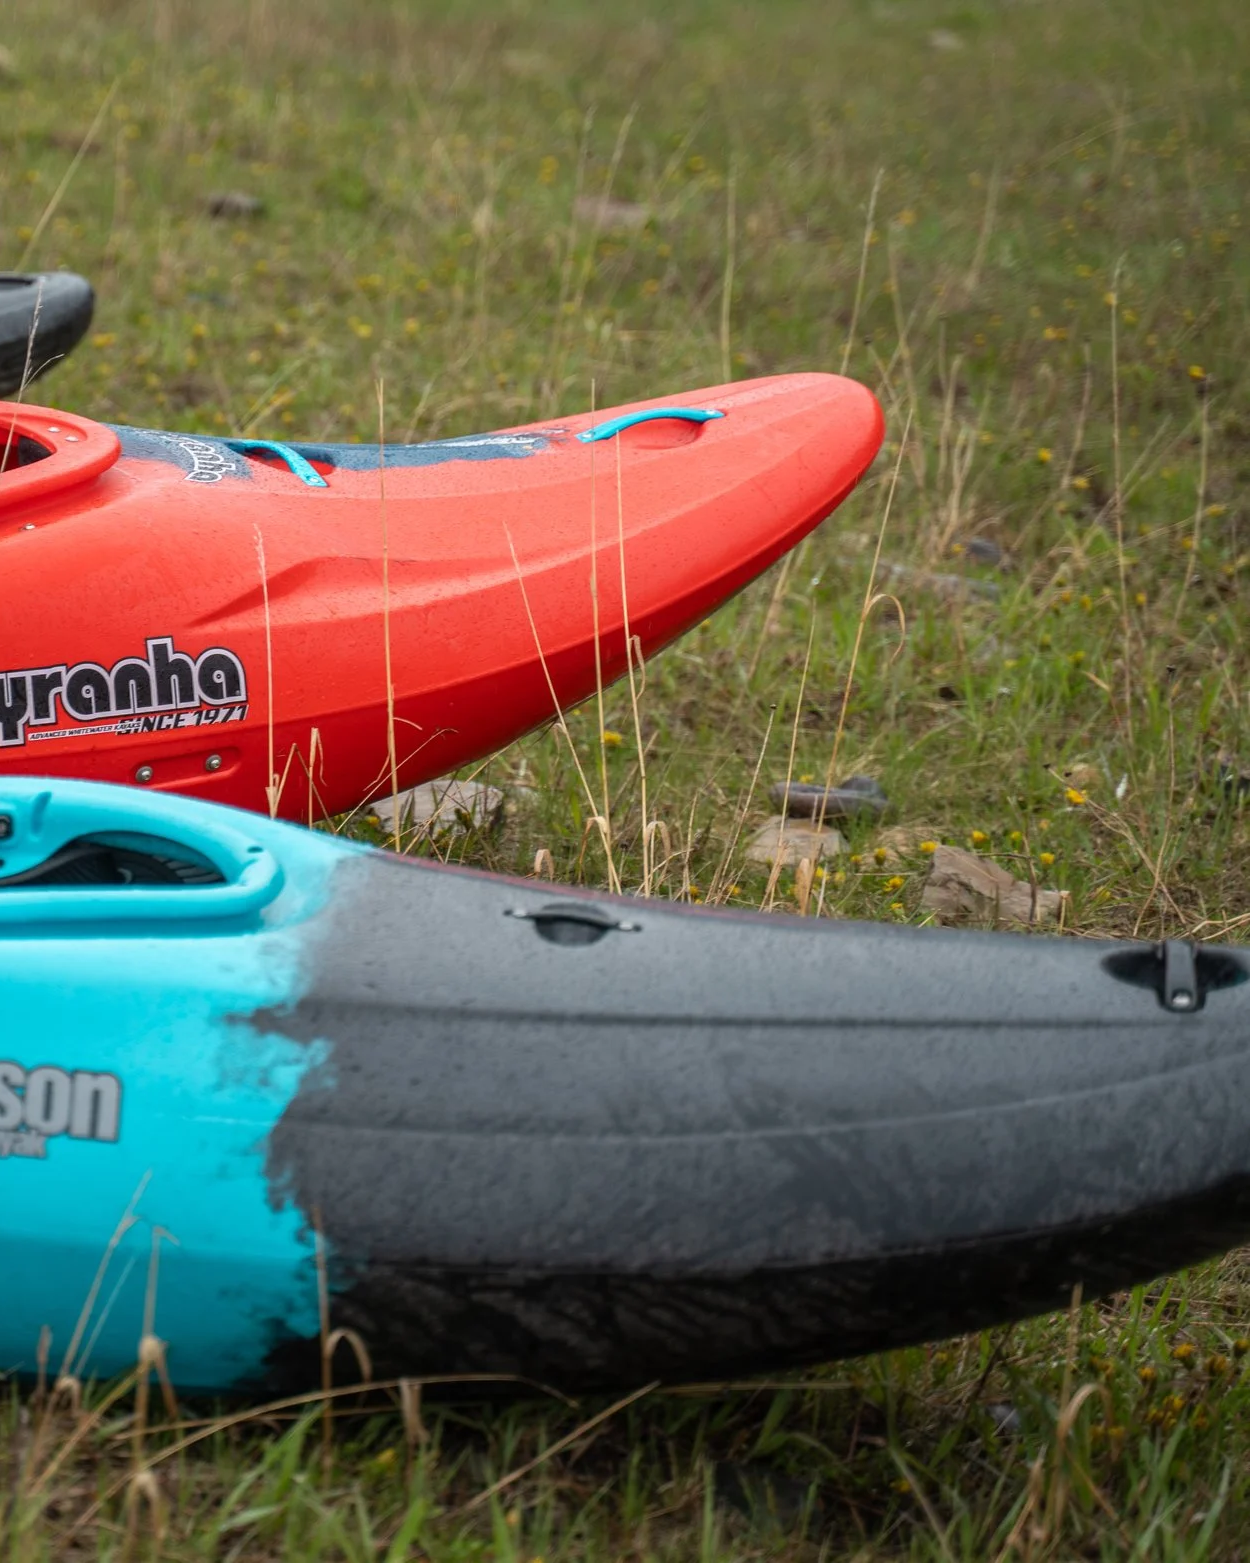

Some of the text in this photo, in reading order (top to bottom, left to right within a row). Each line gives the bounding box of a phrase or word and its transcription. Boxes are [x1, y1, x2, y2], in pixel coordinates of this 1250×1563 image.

[193, 704, 249, 726] 1971
[29, 721, 141, 740] ADVANCED WHITEWATER KAYAKS
